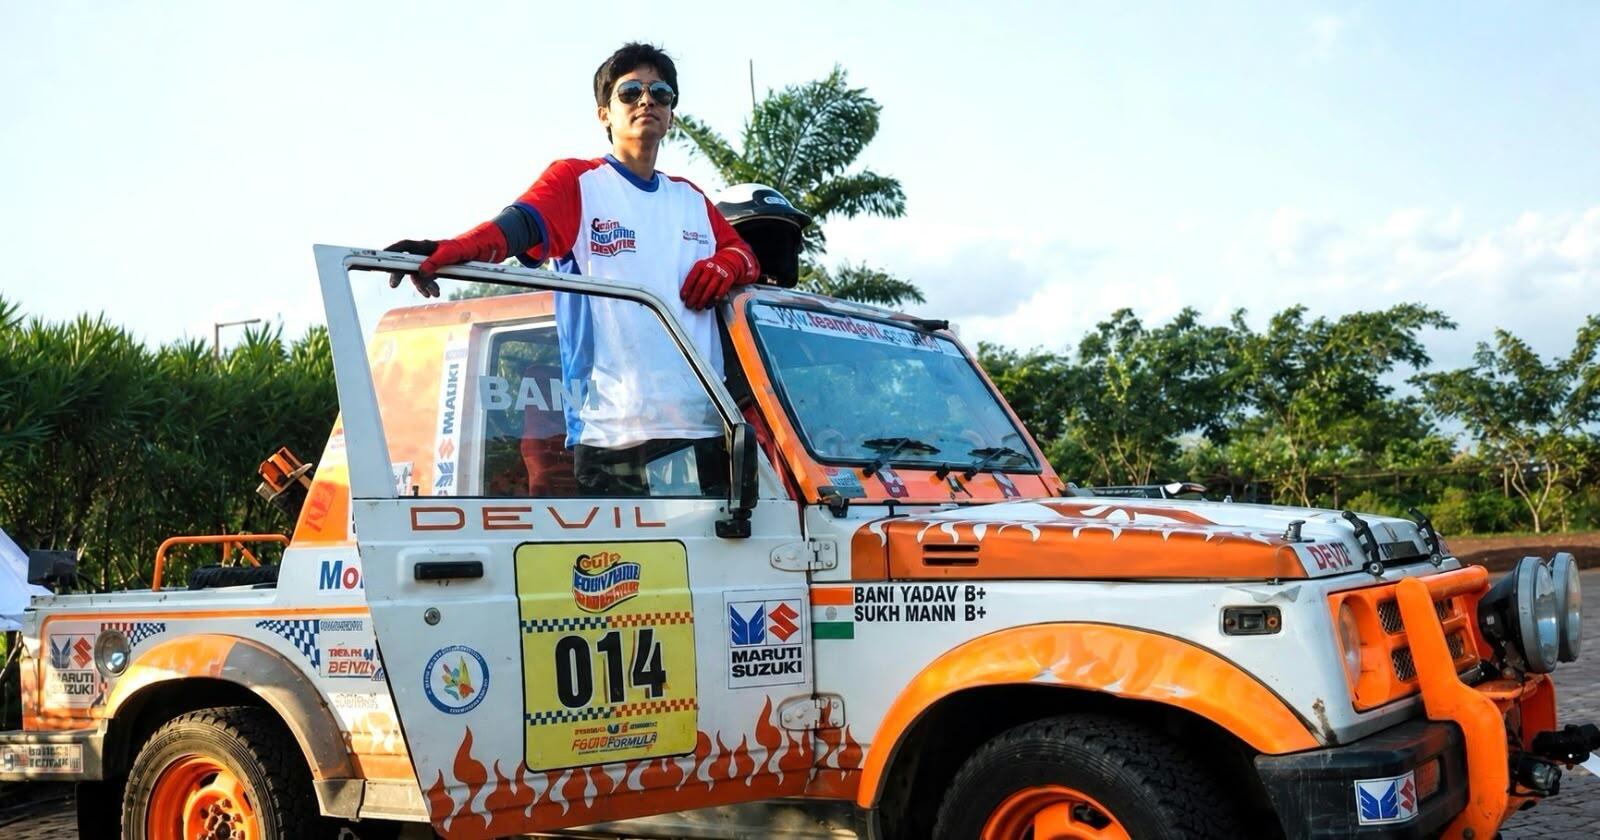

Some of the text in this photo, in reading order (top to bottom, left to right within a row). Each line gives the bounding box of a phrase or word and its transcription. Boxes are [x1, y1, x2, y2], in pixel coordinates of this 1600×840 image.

[478, 375, 600, 411] BANI
[410, 507, 666, 531] DEVIL
[320, 560, 363, 590] Mo
[854, 585, 987, 604] BANI YADAV B+
[854, 604, 987, 622] SUKH MANN B+
[731, 647, 802, 664] MARUTI
[555, 628, 667, 709] 014
[731, 660, 802, 678] SUZUKI
